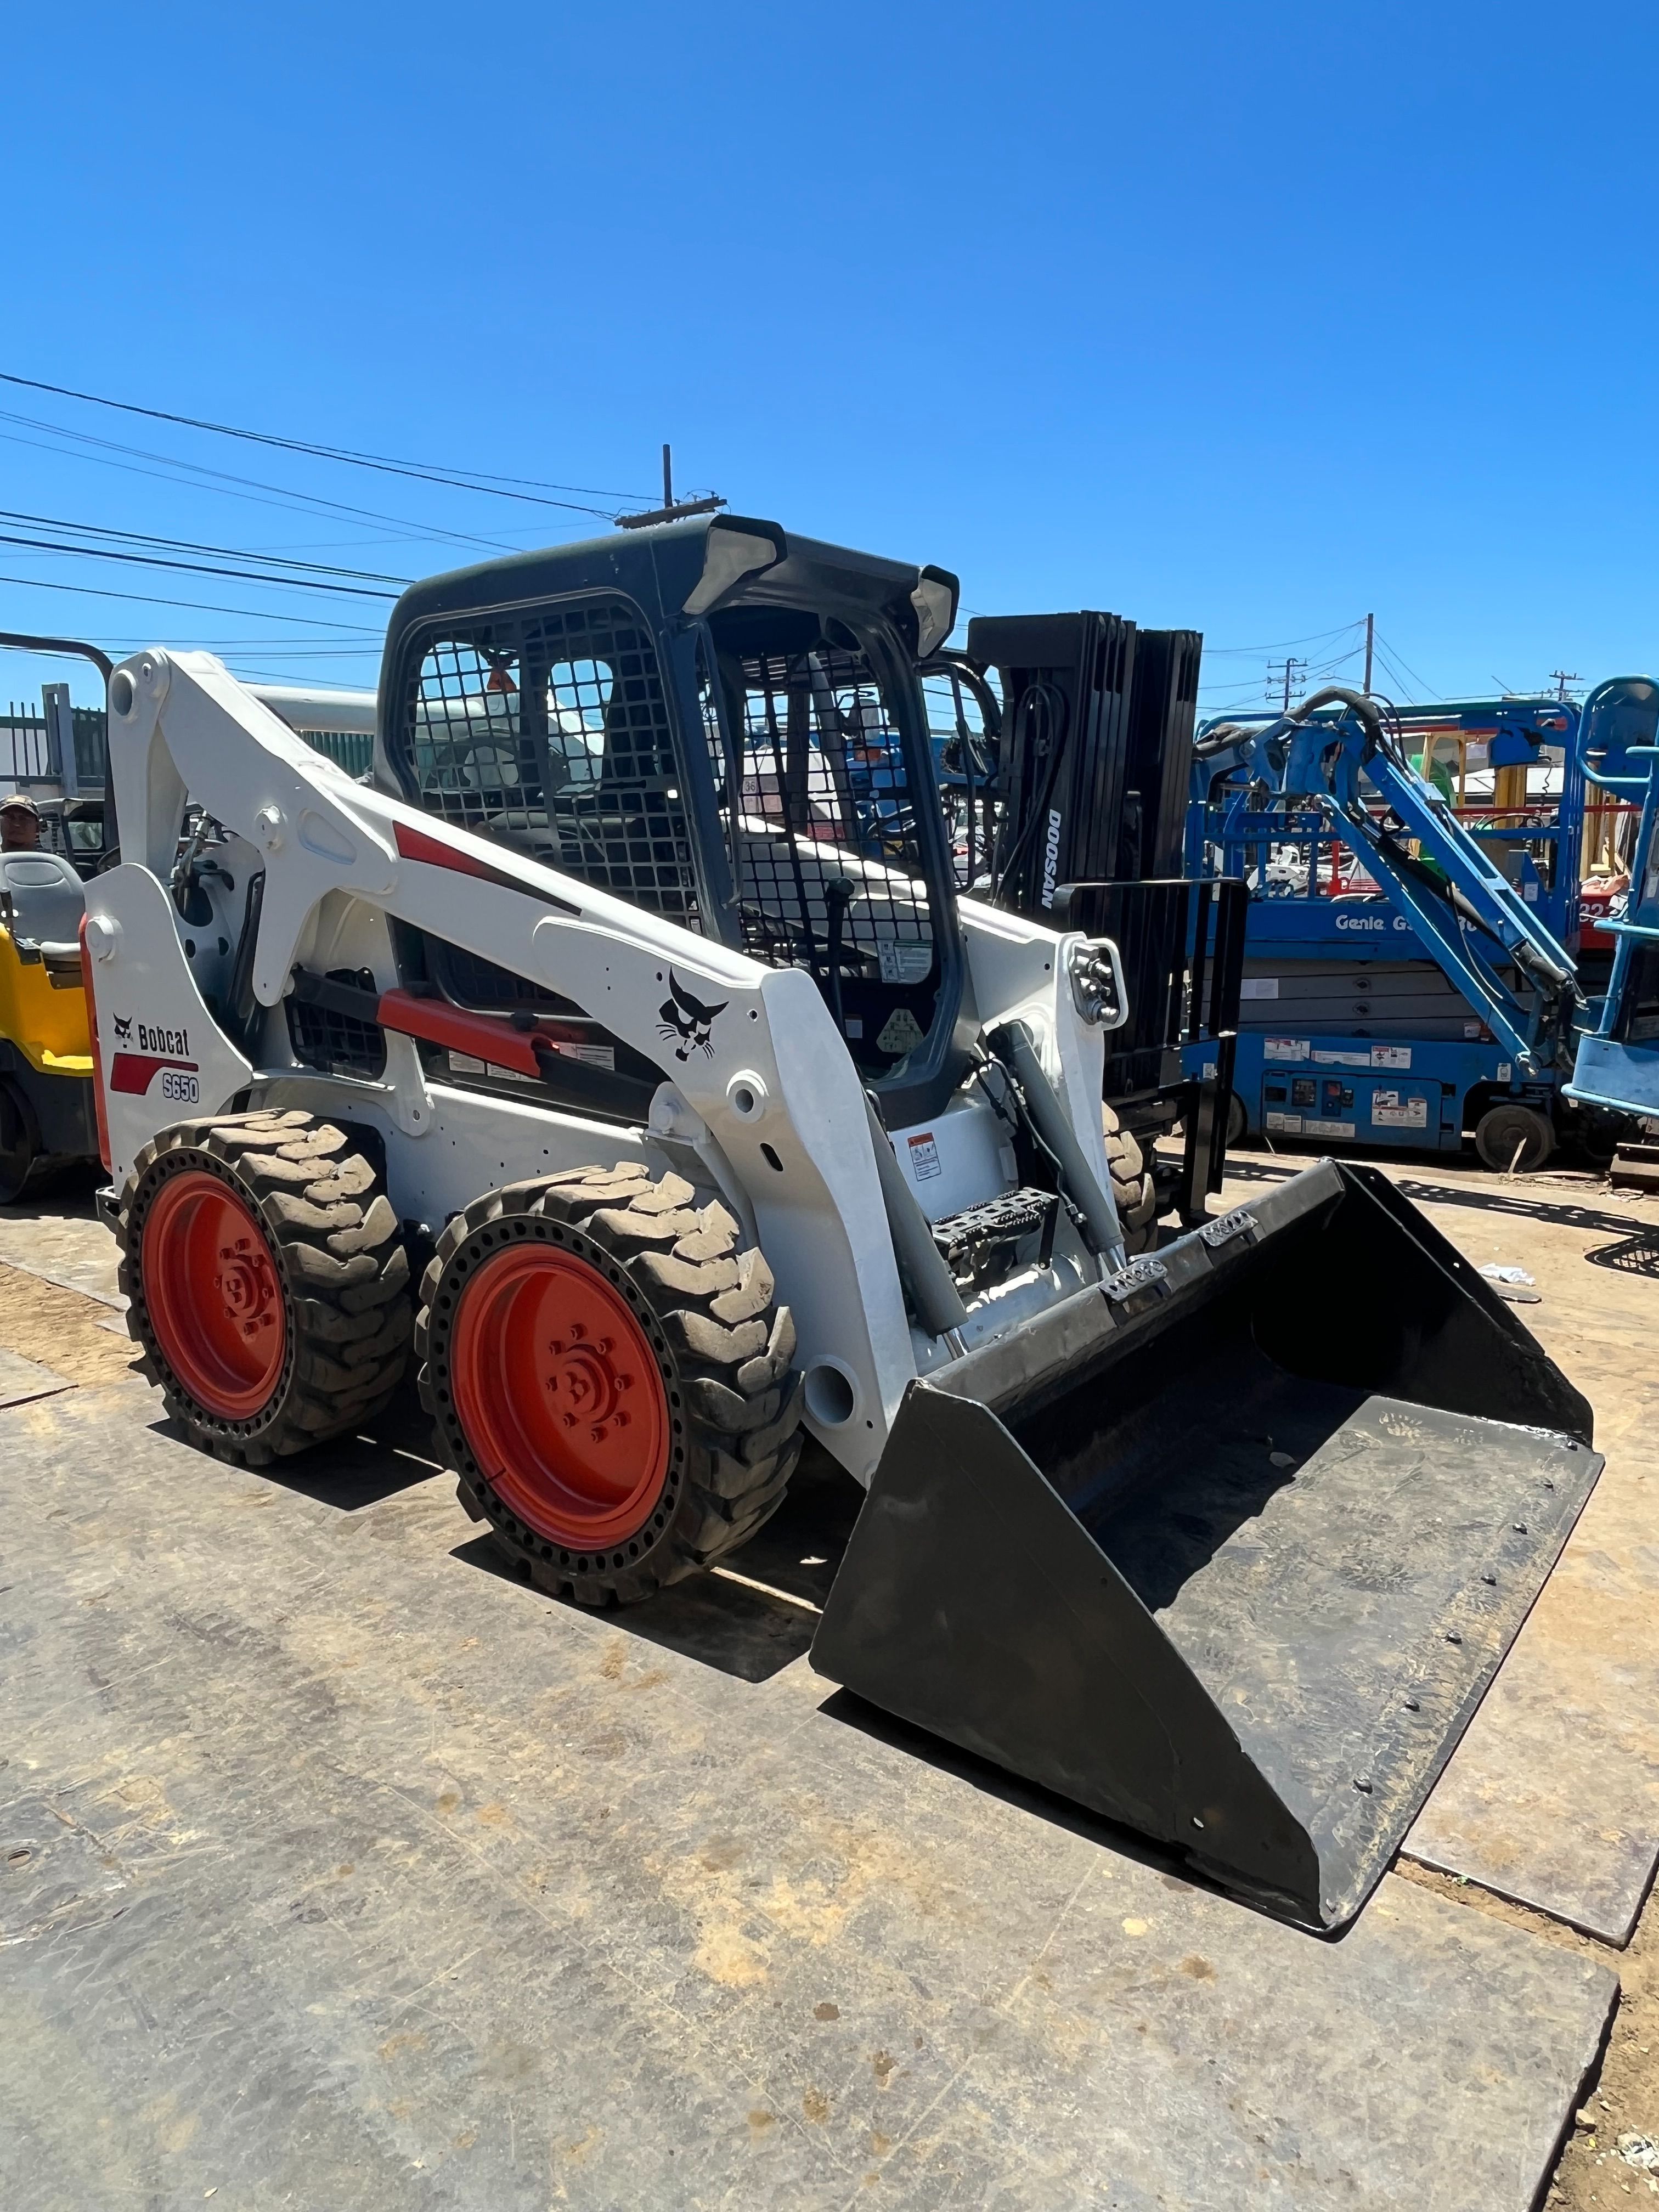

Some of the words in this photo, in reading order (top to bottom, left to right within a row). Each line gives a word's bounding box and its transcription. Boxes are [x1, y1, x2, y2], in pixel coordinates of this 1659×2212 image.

[1042, 809, 1062, 910] DOOSAN
[1336, 915, 1384, 930] Genie
[138, 1024, 190, 1056] Bobcat
[162, 1072, 199, 1104] S650
